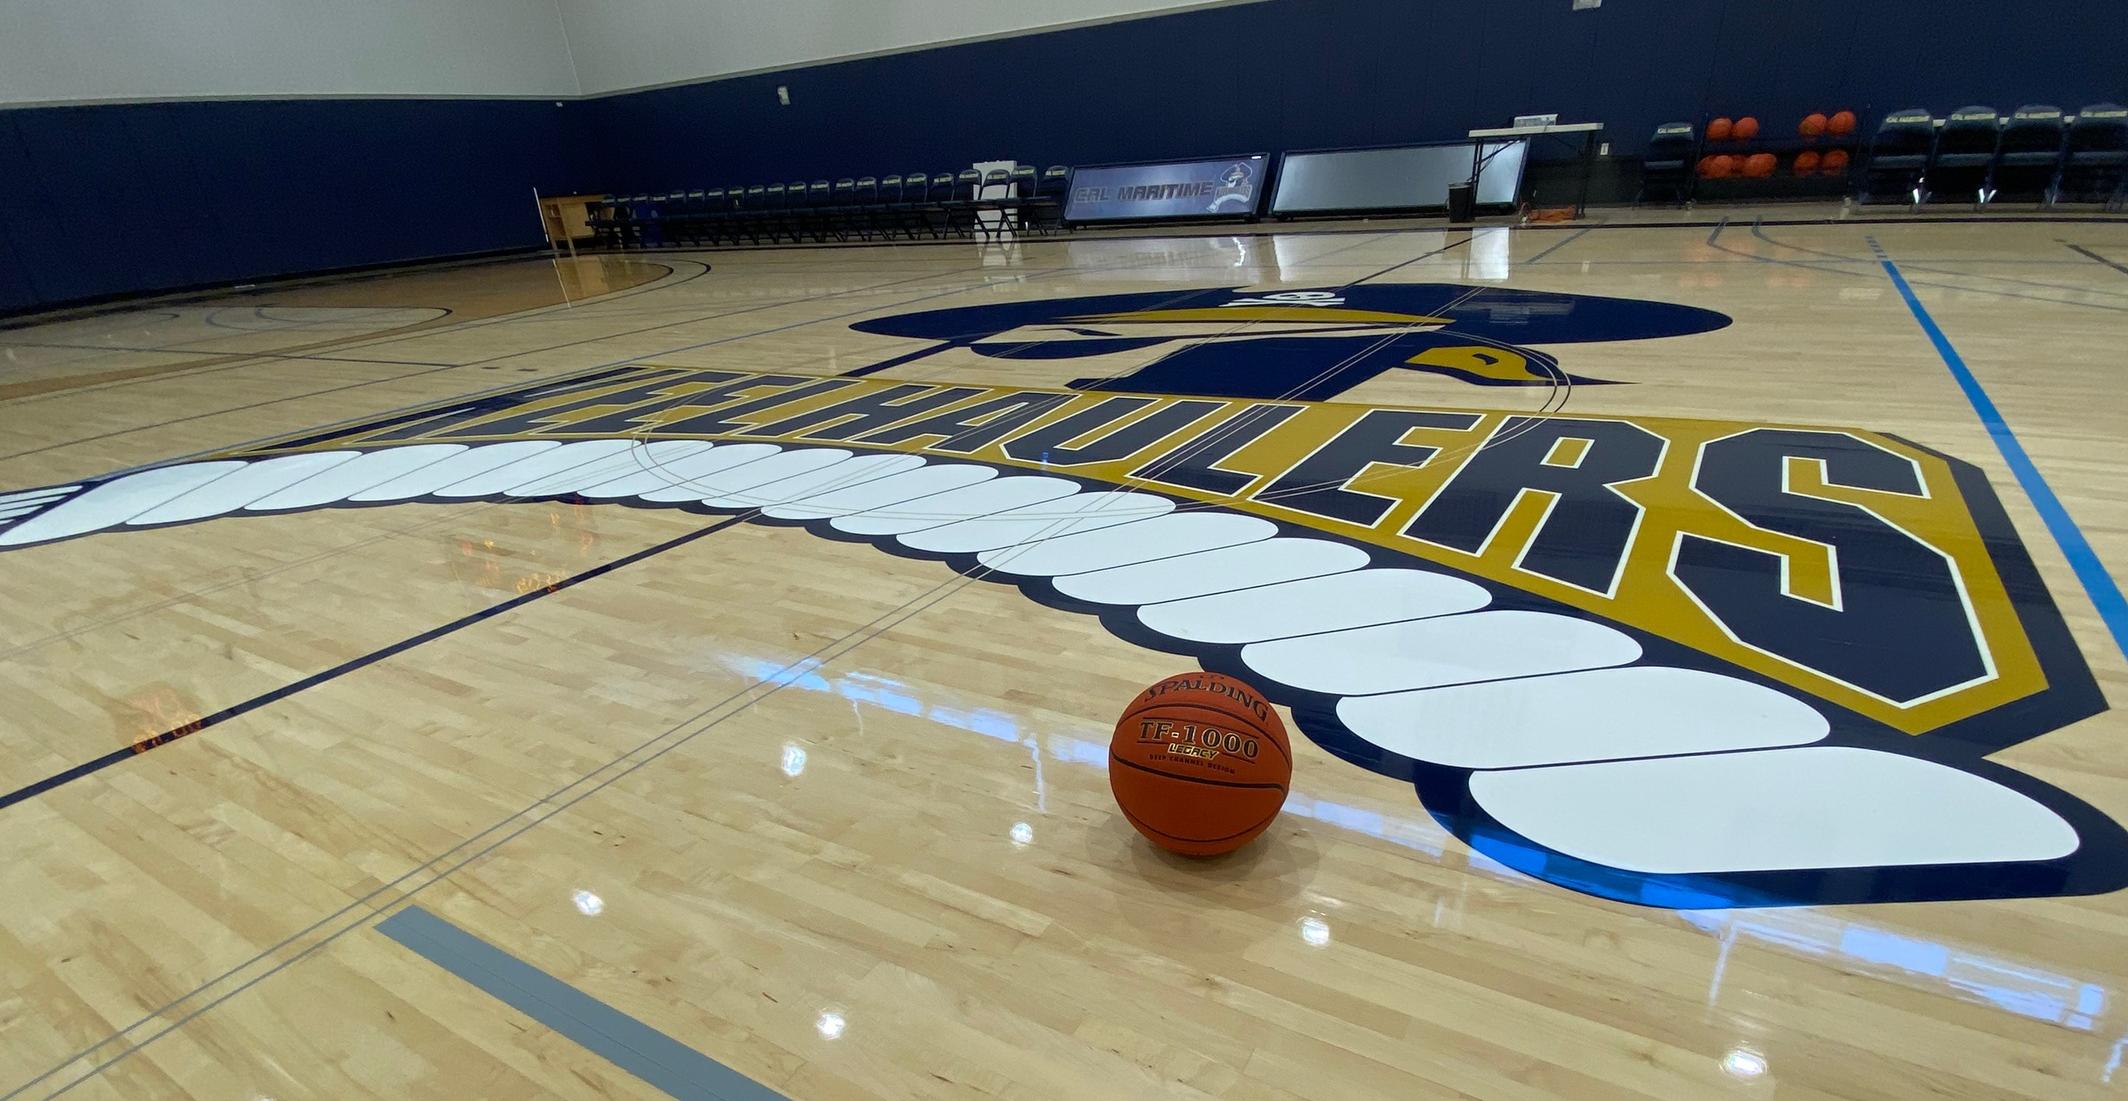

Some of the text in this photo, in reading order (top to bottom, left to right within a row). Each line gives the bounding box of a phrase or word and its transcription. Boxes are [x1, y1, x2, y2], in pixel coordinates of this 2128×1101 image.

[1074, 185, 1109, 203] CAL
[1118, 181, 1215, 201] MARITIME
[232, 365, 1998, 708] KEELHAULERS
[1143, 678, 1270, 722] SPALDING
[1139, 720, 1260, 759] TF-1000
[1168, 742, 1219, 760] LEGACY
[1169, 756, 1204, 767] CHANNEL
